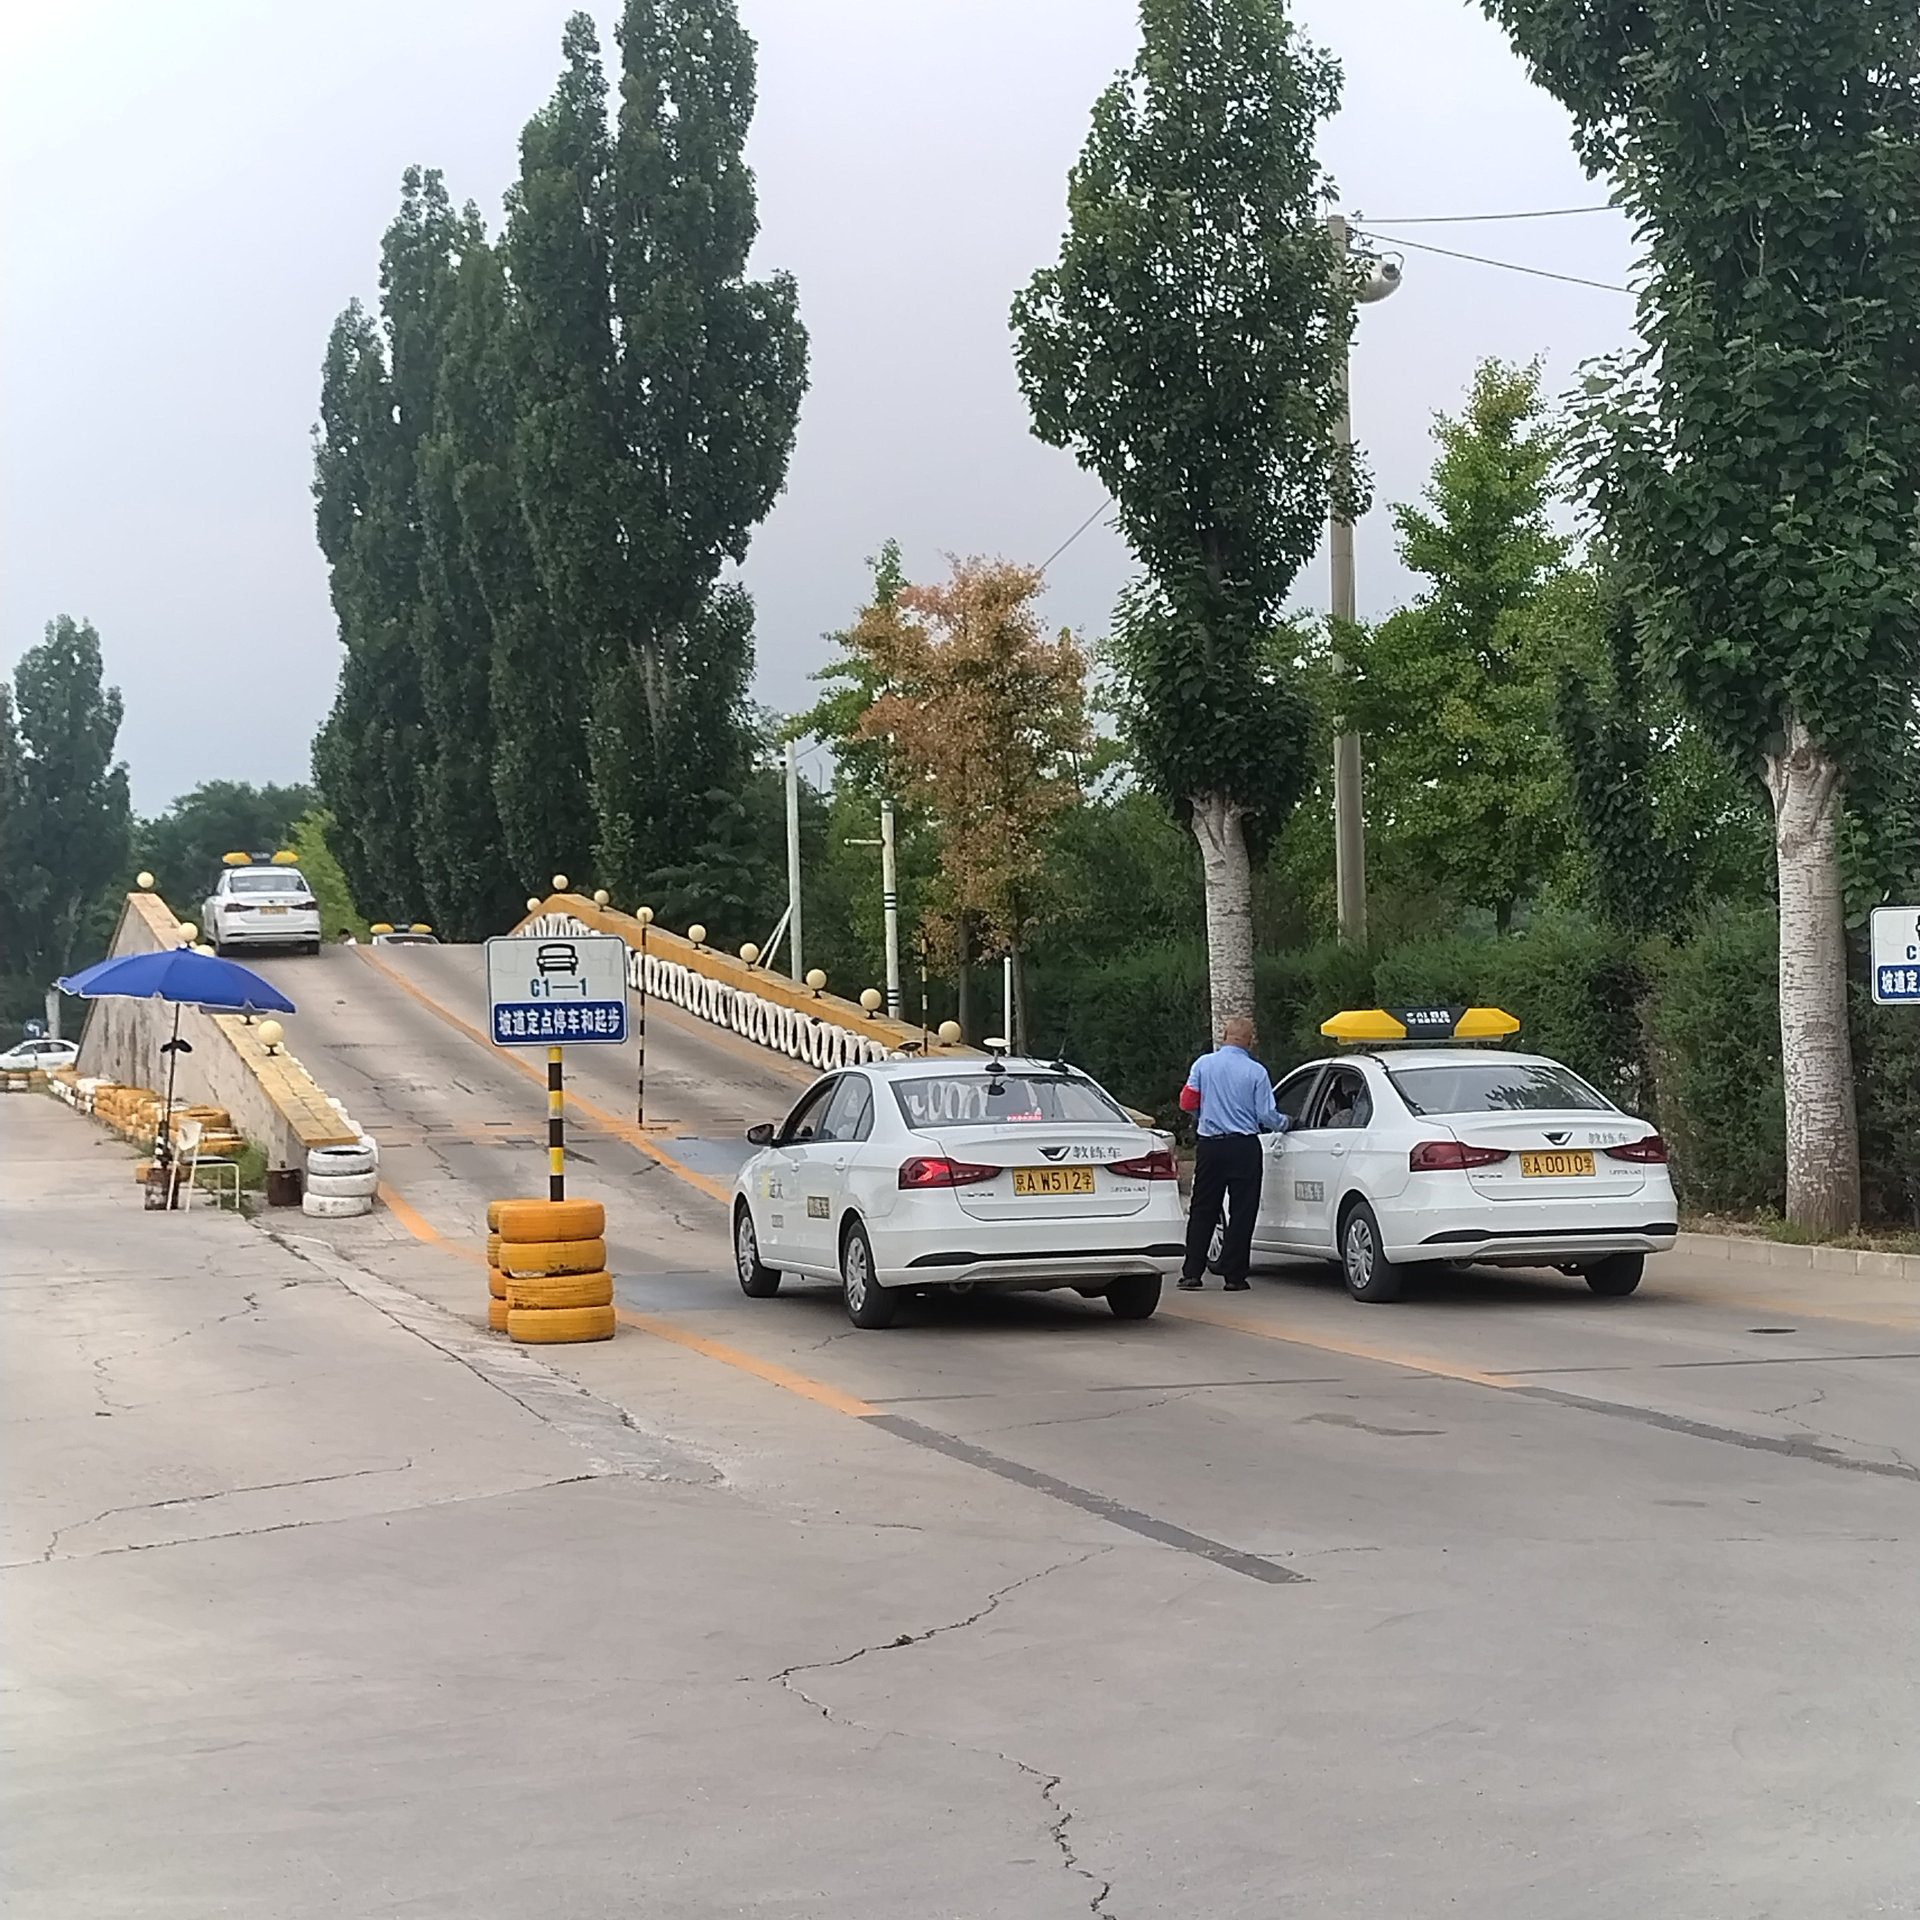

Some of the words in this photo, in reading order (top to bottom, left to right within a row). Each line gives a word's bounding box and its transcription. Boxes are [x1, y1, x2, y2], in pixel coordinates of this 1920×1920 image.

[1881, 970, 1920, 994] 坡道定
[498, 1006, 621, 1036] 坡道定点停车和起步
[1072, 1146, 1122, 1159] 教练车
